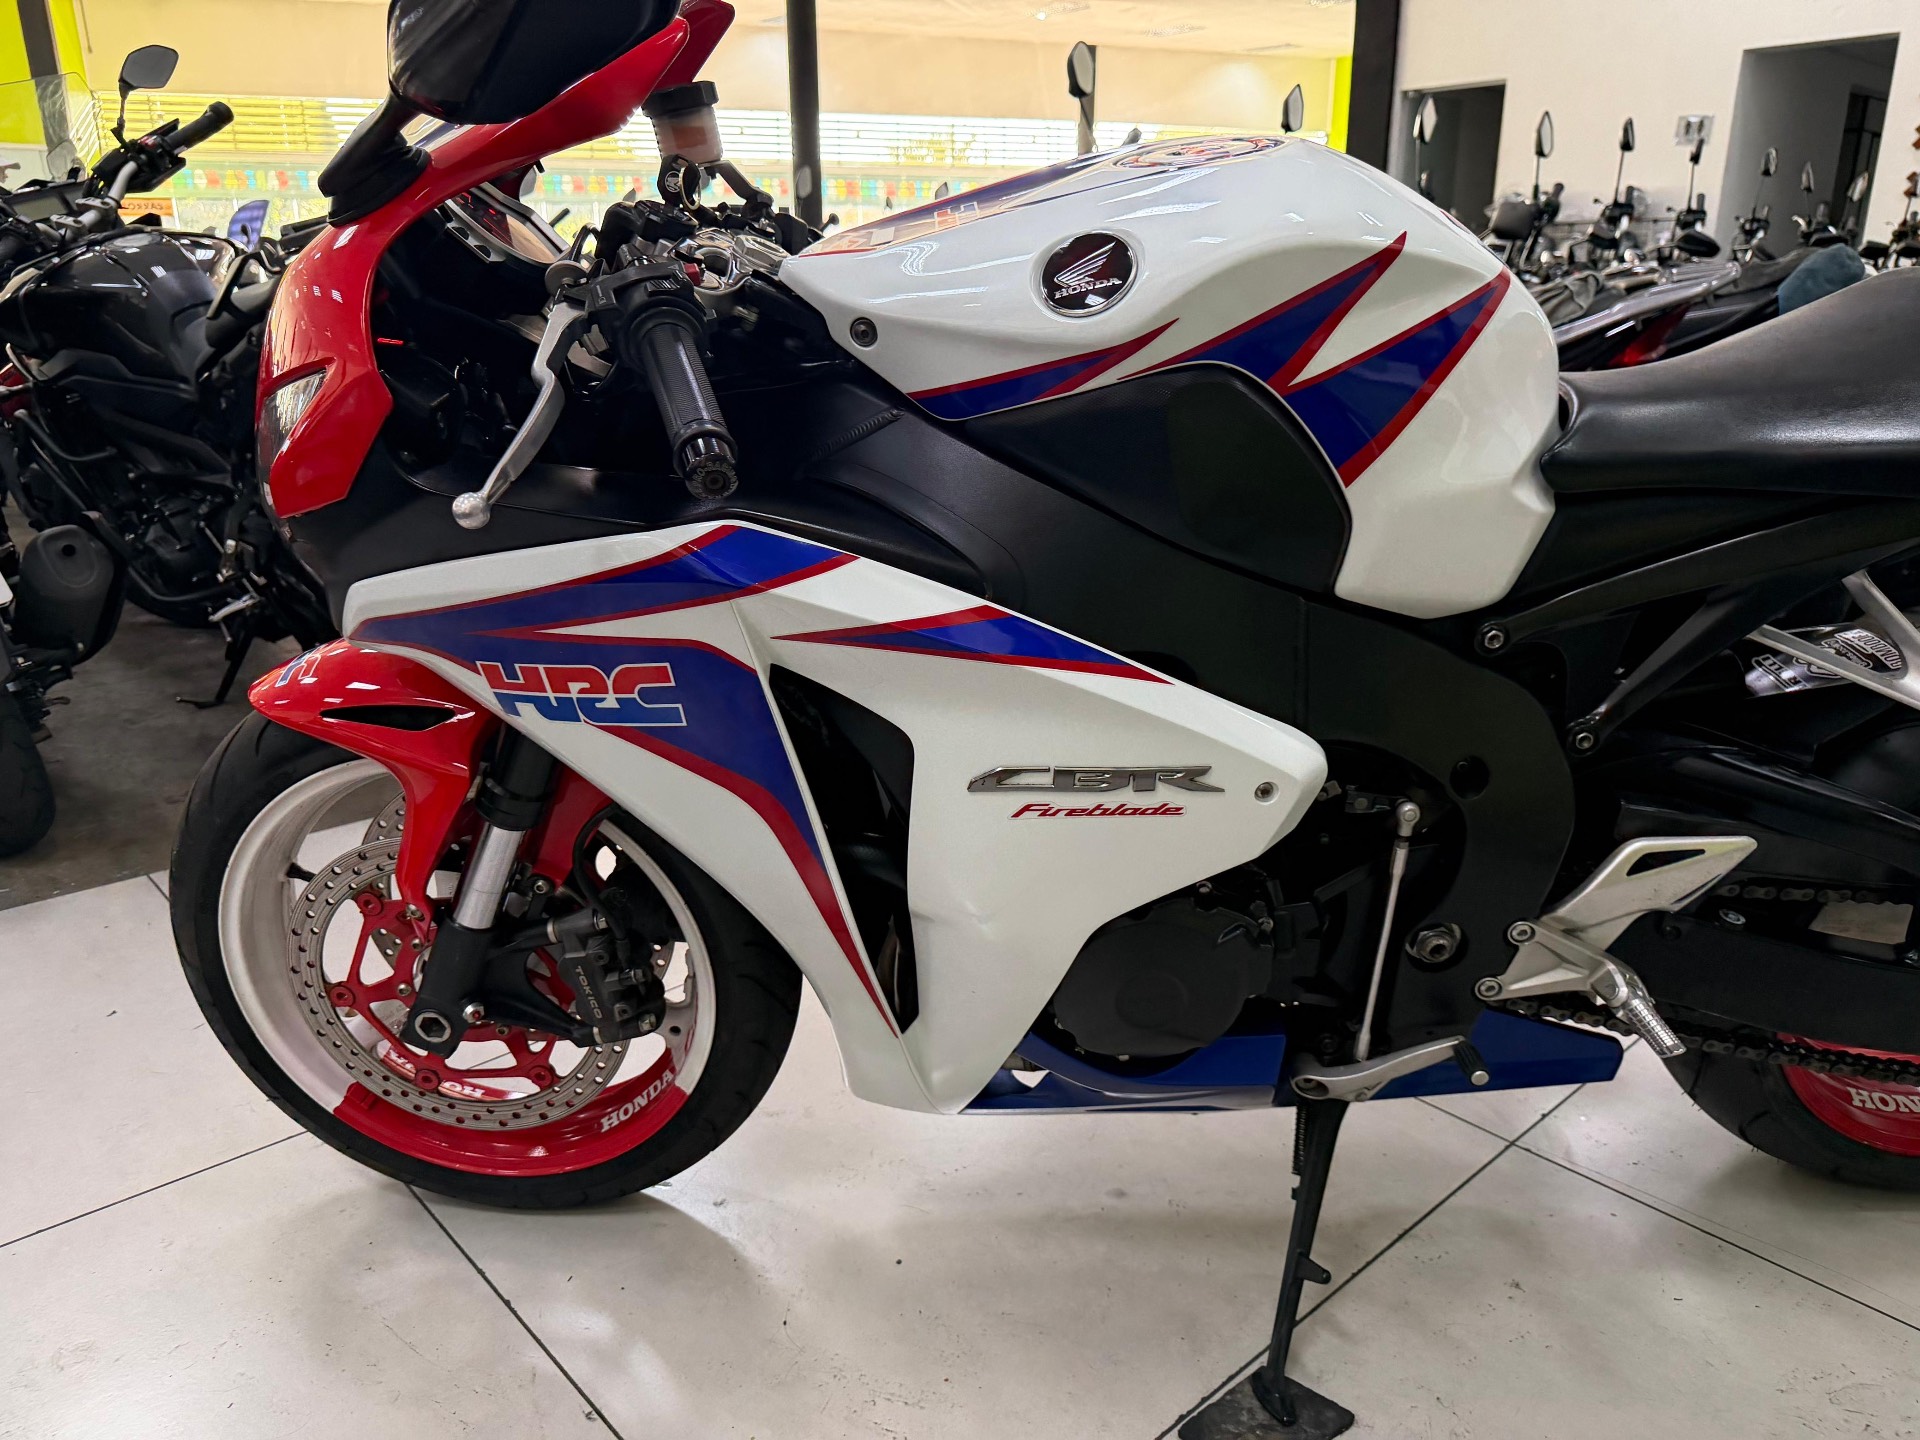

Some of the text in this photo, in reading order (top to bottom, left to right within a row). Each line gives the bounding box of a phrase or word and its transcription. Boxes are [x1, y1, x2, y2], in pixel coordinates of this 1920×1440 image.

[1054, 278, 1122, 299] HONDA
[475, 660, 687, 726] HRC
[967, 766, 1225, 792] CBR
[1010, 803, 1184, 818] Fireblade
[575, 965, 602, 1019] TOKICO
[601, 1068, 675, 1133] HONDA
